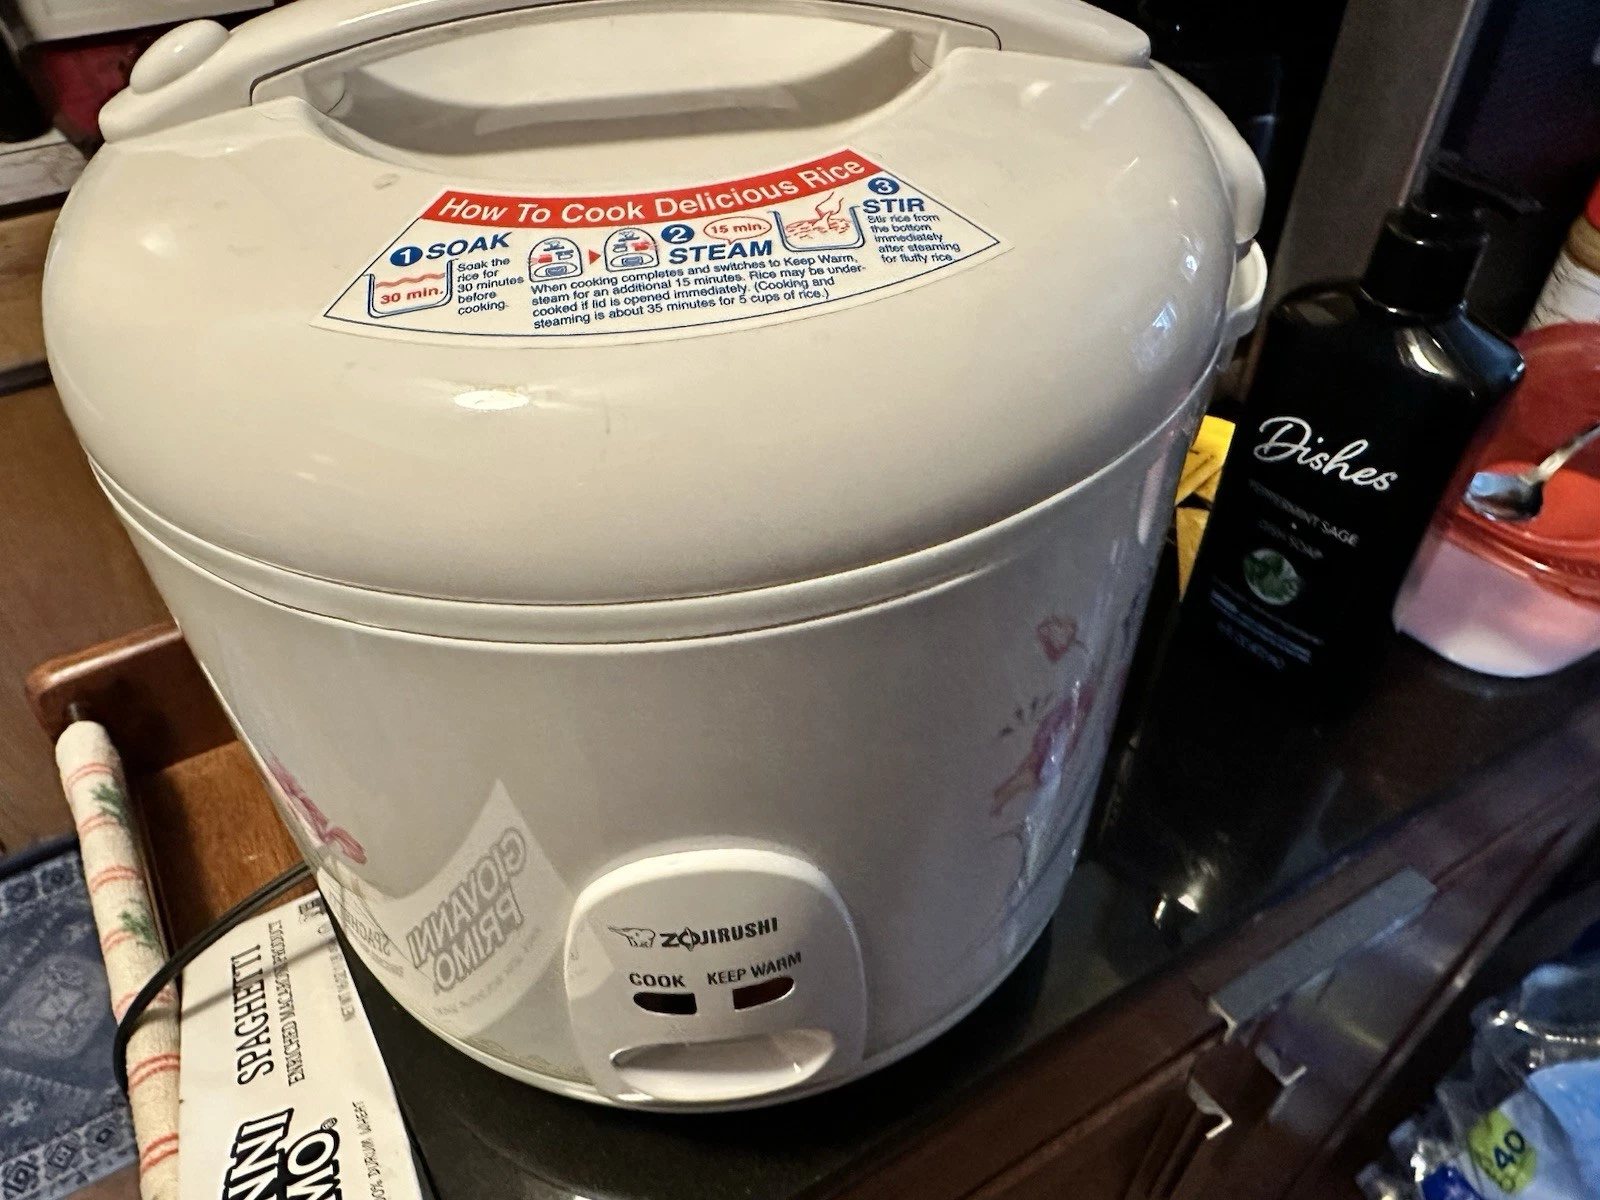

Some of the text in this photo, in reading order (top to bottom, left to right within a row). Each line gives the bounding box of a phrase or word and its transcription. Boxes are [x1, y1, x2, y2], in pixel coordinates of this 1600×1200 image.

[439, 159, 866, 223] How To Cook Delicious Rice
[862, 198, 925, 214] STIR
[867, 213, 940, 224] Stir rice from
[711, 222, 766, 234] 15 min.
[870, 223, 932, 233] the bottom
[426, 231, 512, 260] SOAK
[874, 232, 943, 243] immediately
[669, 240, 773, 264] STEAM
[878, 242, 961, 253] after steaming
[457, 257, 510, 272] Soak the
[881, 254, 898, 263] for
[900, 253, 928, 264] fluffy
[458, 268, 499, 282] rice for
[531, 253, 858, 294] When cooking completes and switches to Keep Warm,
[457, 276, 525, 293] 30 minutes
[532, 263, 867, 306] steam for an additional 15 minutes. Rice may be under-
[380, 286, 444, 305] 30 min.
[458, 291, 497, 304] before
[532, 302, 578, 317] cooked
[581, 299, 589, 310] if
[592, 298, 607, 308] lid
[610, 296, 621, 306] is
[624, 291, 671, 307] opened
[754, 277, 809, 293] (Cooking
[812, 276, 835, 287] and
[533, 287, 830, 329] steaming is about 35 minutes for 5 cups of rice.)
[1253, 416, 1398, 491] Dishes
[659, 916, 779, 952] ZOJIRUSHI
[706, 951, 802, 986] KEEP WARM
[629, 972, 687, 988] COOK
[231, 943, 275, 1086] SPAGHETTI
